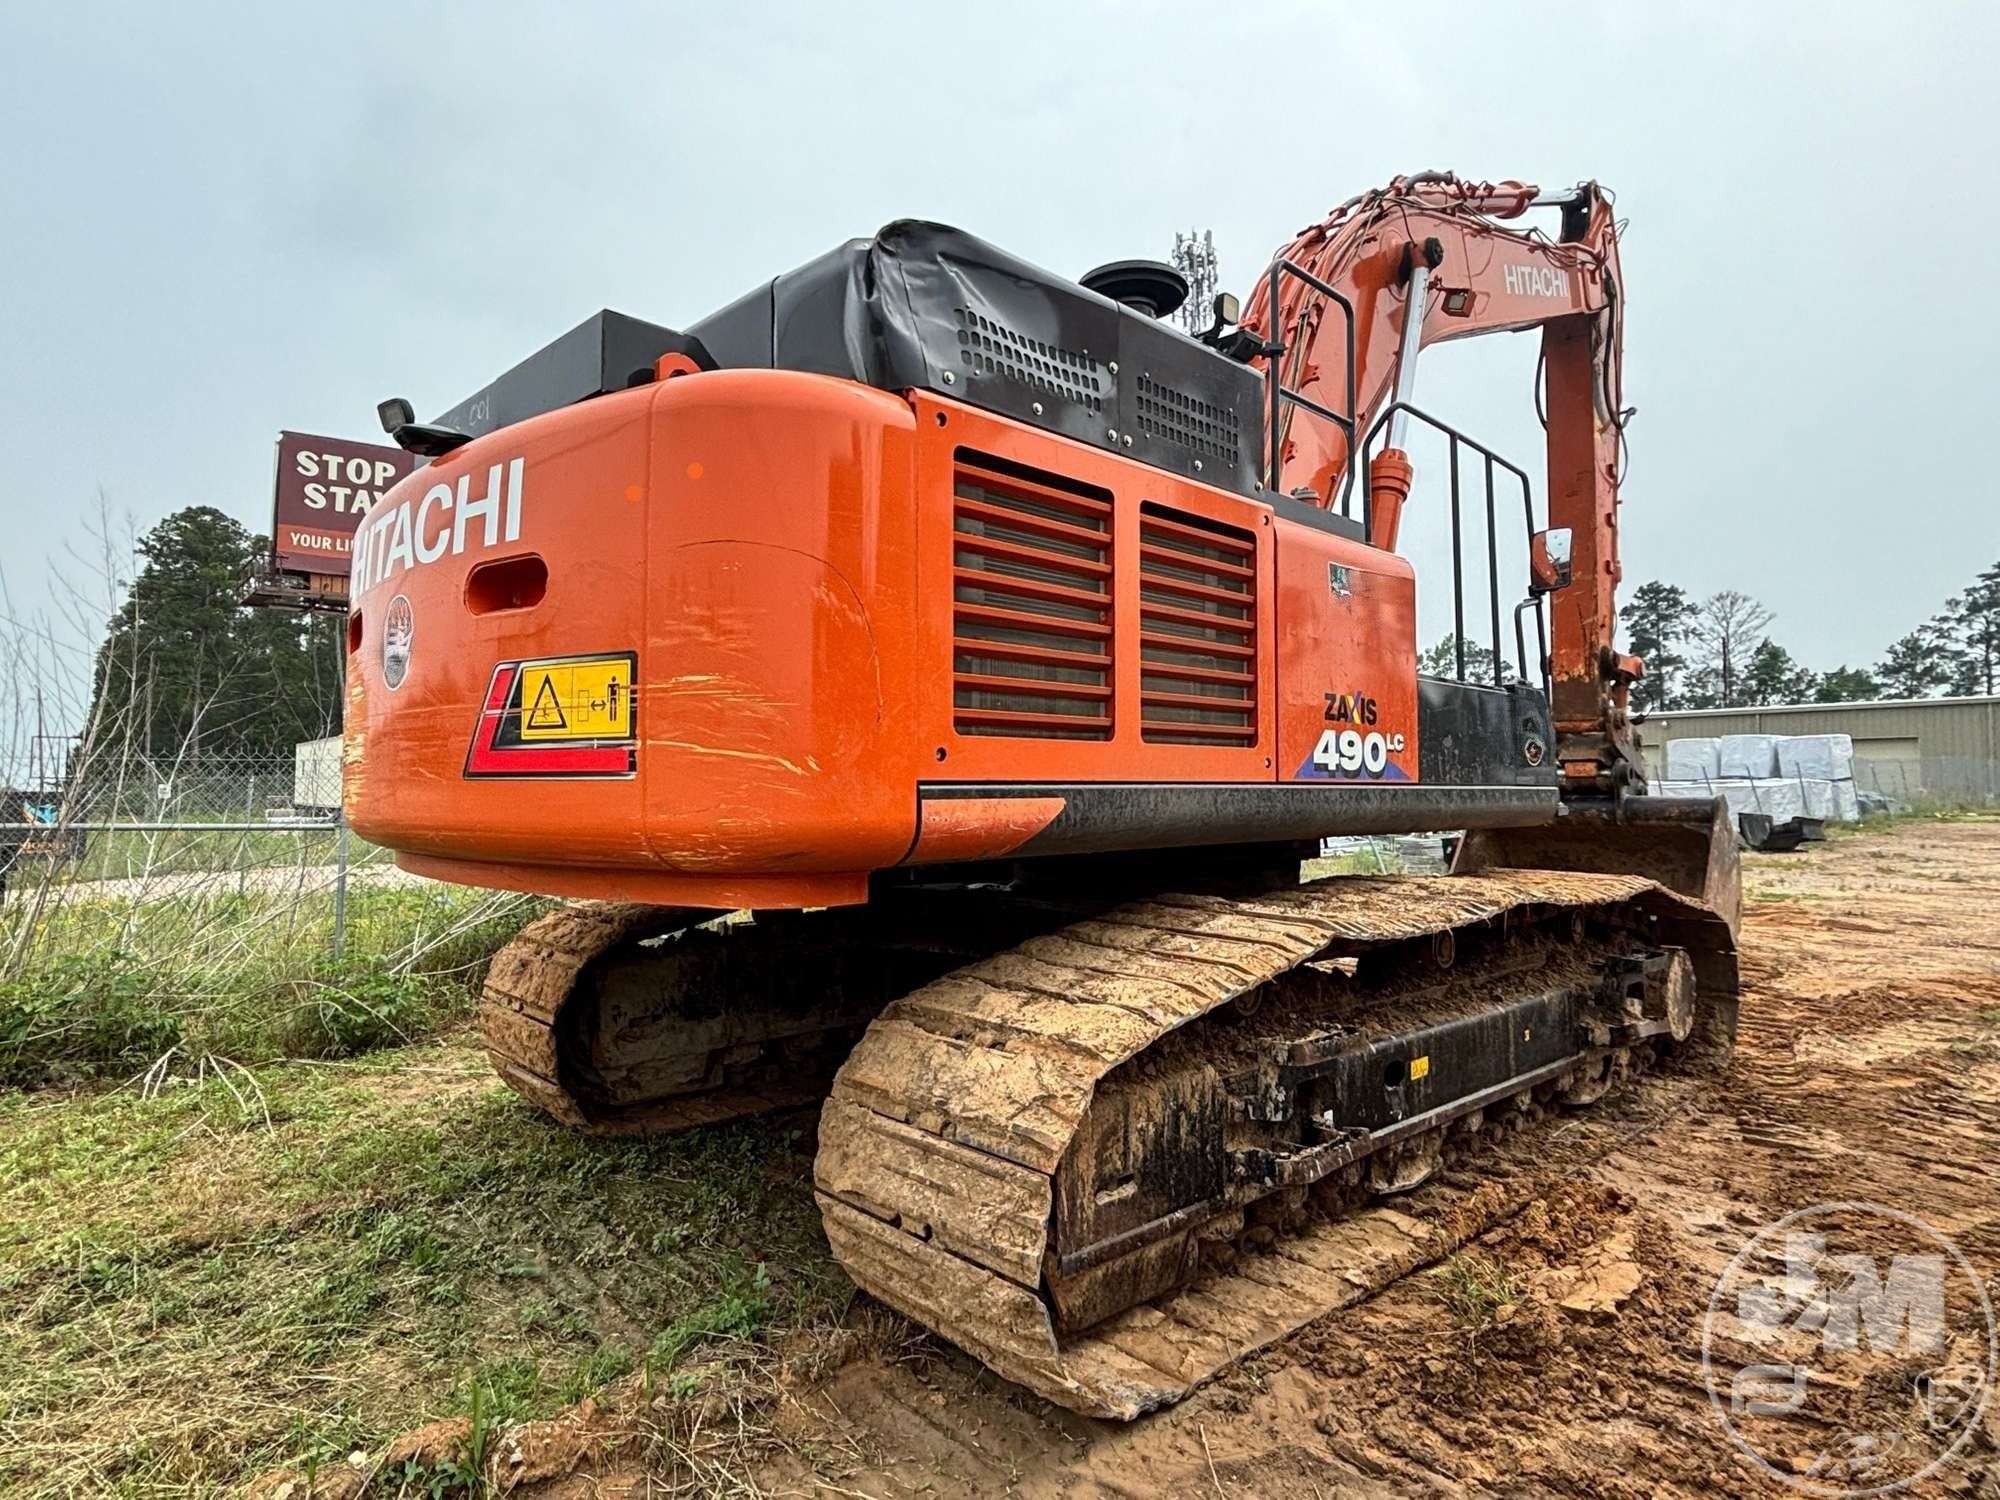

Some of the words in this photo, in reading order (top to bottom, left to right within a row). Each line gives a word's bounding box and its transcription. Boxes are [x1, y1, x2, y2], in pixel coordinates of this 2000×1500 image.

[1503, 264, 1569, 297] HITACHI
[296, 450, 396, 486] STOP
[290, 532, 332, 550] YOUR
[351, 457, 525, 604] HITACHI
[1324, 690, 1378, 726] ZAXIS
